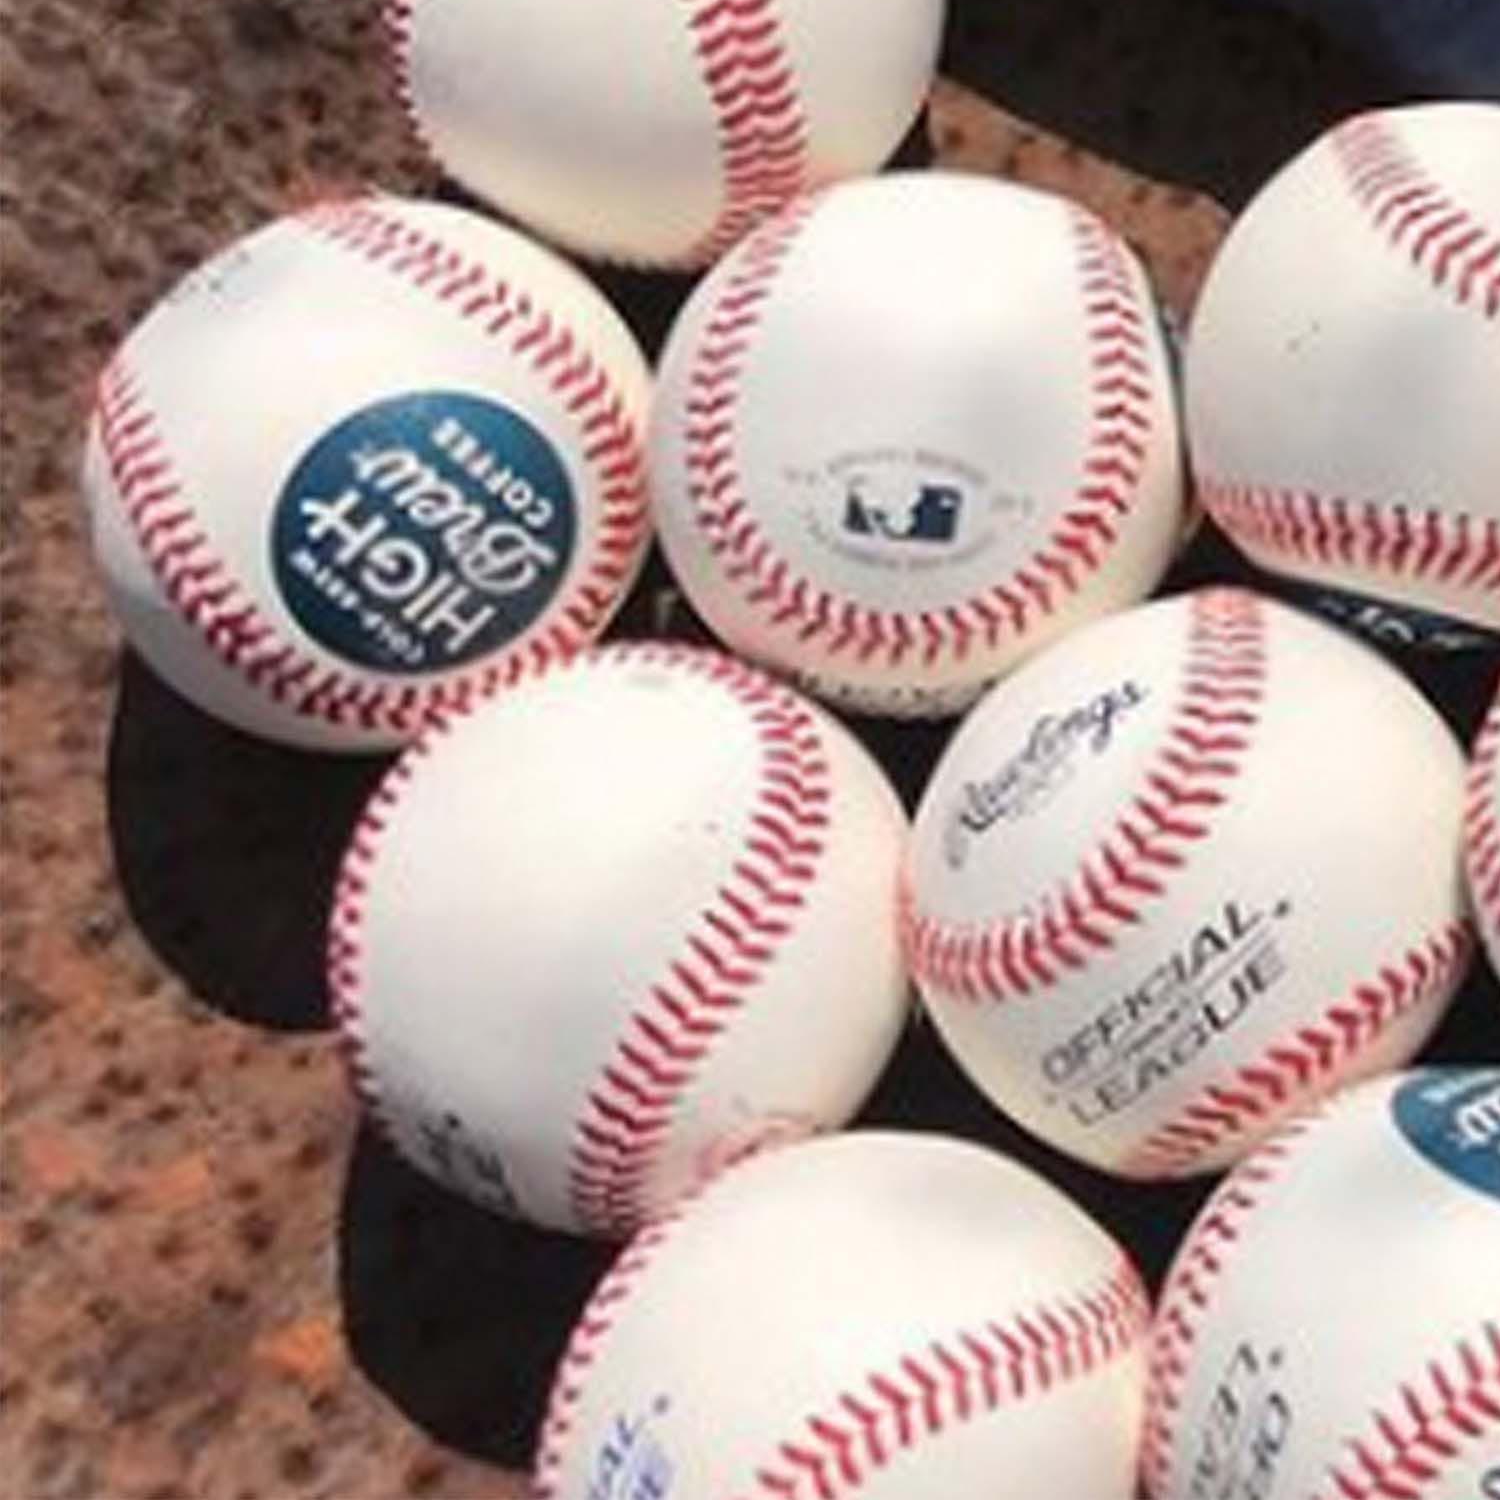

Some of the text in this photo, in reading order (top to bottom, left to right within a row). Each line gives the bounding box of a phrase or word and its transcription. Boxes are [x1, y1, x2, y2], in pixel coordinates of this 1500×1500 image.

[352, 442, 558, 595] Brew
[431, 417, 553, 528] COFFEE
[301, 488, 496, 653] HIGH
[1041, 900, 1263, 1086] OFFICIAL
[1067, 941, 1288, 1128] LEAGUE
